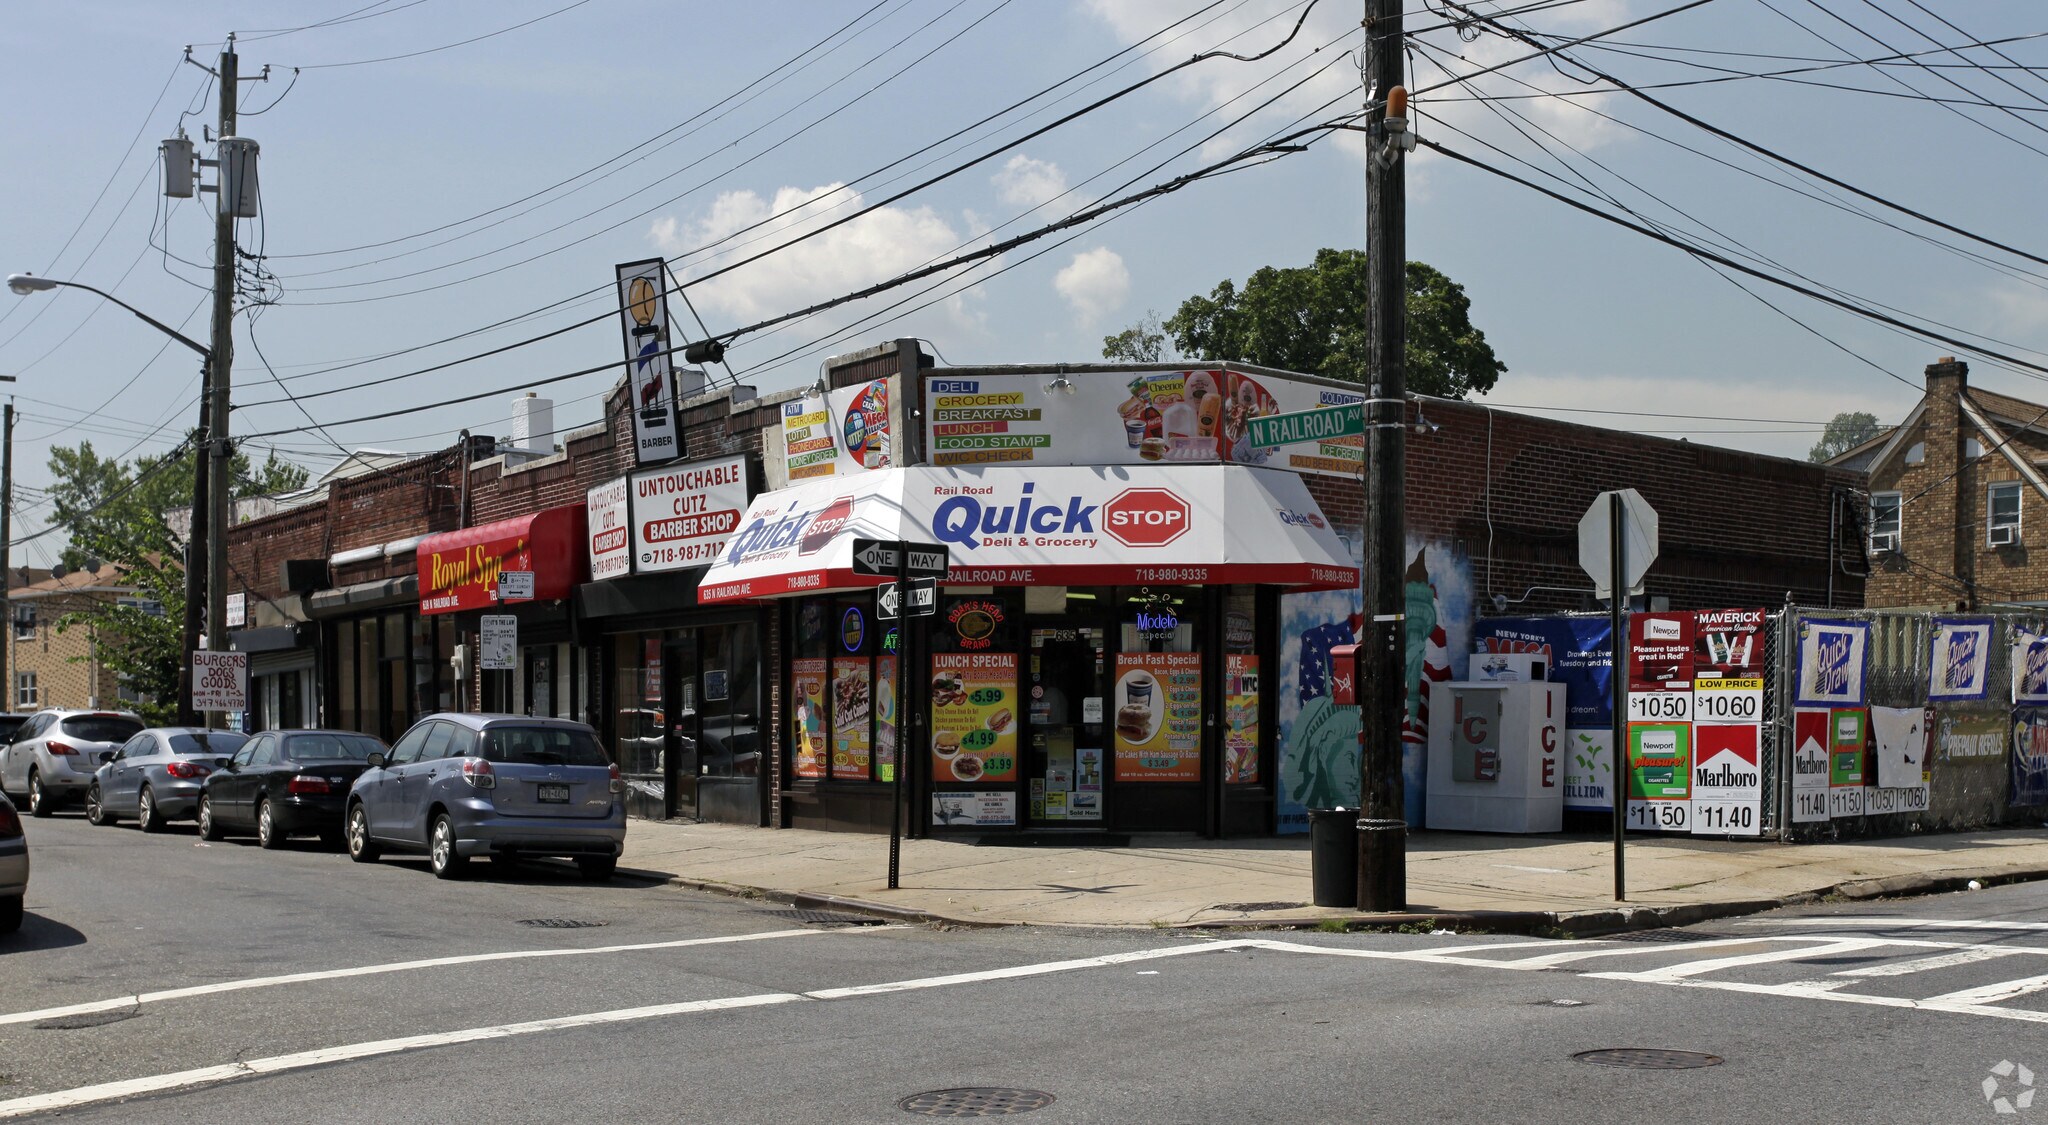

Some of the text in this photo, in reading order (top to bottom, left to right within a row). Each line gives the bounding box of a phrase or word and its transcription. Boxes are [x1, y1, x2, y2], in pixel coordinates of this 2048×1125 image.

[938, 382, 973, 393] DELI
[1149, 383, 1184, 392] Cheerios
[938, 395, 1020, 407] GROCERY
[1321, 392, 1342, 405] COLD
[787, 405, 800, 416] ATM
[938, 409, 1034, 421] BREAKFAST
[787, 412, 825, 428] METROCARD
[863, 411, 887, 428] MEGA
[1253, 407, 1361, 445] N RAILROAD AV
[788, 429, 807, 440] LOTTO
[938, 423, 994, 435] LUNCH
[642, 436, 672, 449] BARBER
[789, 438, 831, 454] PHONECARDS
[939, 436, 1045, 449] FOOD STAMP
[790, 450, 834, 468] MONEY ORDER
[938, 450, 1033, 463] WIC CHECK
[1322, 446, 1363, 461] ICE CREAM
[1290, 456, 1311, 468] COLD
[1312, 459, 1334, 470] BEER
[791, 464, 827, 480] QUICKDRAW
[639, 464, 739, 498] UNTOUCHABLE
[590, 484, 626, 512] UNTOUCHABLE
[934, 486, 993, 495] Rail Road
[673, 494, 707, 516] CUTZ
[602, 510, 615, 530] CUTZ
[932, 482, 1099, 551] Quick
[1111, 510, 1182, 526] STOP
[1280, 509, 1310, 526] Quick
[650, 513, 734, 540] BARBER SHOP
[727, 500, 811, 568] Quick
[808, 517, 845, 536] STOP
[612, 529, 624, 548] SHOP
[982, 537, 1098, 549] Deli Grocery
[653, 541, 726, 564] 718-987-712
[762, 551, 791, 561] Grocery
[866, 550, 938, 568] ONE WAY
[432, 544, 502, 596] Royal Spa
[947, 570, 1007, 582] RAILROAD
[1009, 570, 1035, 582] AVE.
[1135, 568, 1208, 581] 718-980-9335
[1311, 568, 1354, 584] 718-980-9335
[788, 574, 820, 589] 718-980-9335
[703, 583, 751, 600] 635 N RAILROAD AVE.
[911, 590, 929, 604] WAY
[948, 601, 1005, 623] BOAR'S HEAD
[1699, 612, 1761, 624] MAVERICK
[1136, 613, 1178, 630] Modelo
[1733, 624, 1757, 633] Quality
[1056, 630, 1076, 641] 635
[1496, 629, 1545, 642] NEW YORK'S
[1653, 625, 1679, 636] Newport
[884, 634, 898, 649] AT
[960, 638, 990, 649] BRAND
[1633, 645, 1665, 653] Pleasure
[1638, 652, 1684, 661] great in Red!
[1818, 631, 1847, 673] Quick
[1948, 631, 1975, 669] Quick
[194, 654, 246, 668] BURGERS
[935, 656, 1014, 667] LUNCH SPECIAL
[1118, 654, 1200, 666] Break Fast Special
[1229, 656, 1242, 668] WE
[208, 667, 235, 679] DOGS
[1170, 668, 1180, 676] Eggs
[1824, 662, 1848, 696] Draw
[1953, 658, 1974, 691] Draw
[201, 677, 237, 689] GOODS
[1180, 676, 1195, 684] 2.99
[1242, 677, 1258, 692] WIC
[1700, 680, 1758, 688] LOW PRICE
[970, 690, 1002, 703] $5.99
[1180, 693, 1196, 701] 2.49
[1170, 702, 1180, 710] Eggs
[1632, 697, 1687, 718] $10.50
[1698, 696, 1756, 718] $10.60
[962, 733, 994, 745] $4.99
[1455, 694, 1497, 780] ICE
[1541, 690, 1556, 788] ICE
[1643, 742, 1673, 750] Newport
[1948, 733, 2003, 757] PREPAID REFILLS
[1149, 750, 1160, 758] Ham
[1160, 750, 1179, 760] Sausage
[1634, 755, 1686, 769] pleasure!
[1795, 750, 1827, 774] Marlboro
[984, 759, 1012, 770] $3.99
[1696, 763, 1757, 787] Marlboro
[1797, 793, 1825, 815] $11.40
[1832, 792, 1860, 813] $11.50
[1867, 790, 1894, 811] $10.50
[1900, 788, 1926, 809] $10.60
[1631, 806, 1686, 827] $11.50
[1698, 806, 1751, 828] $11.40
